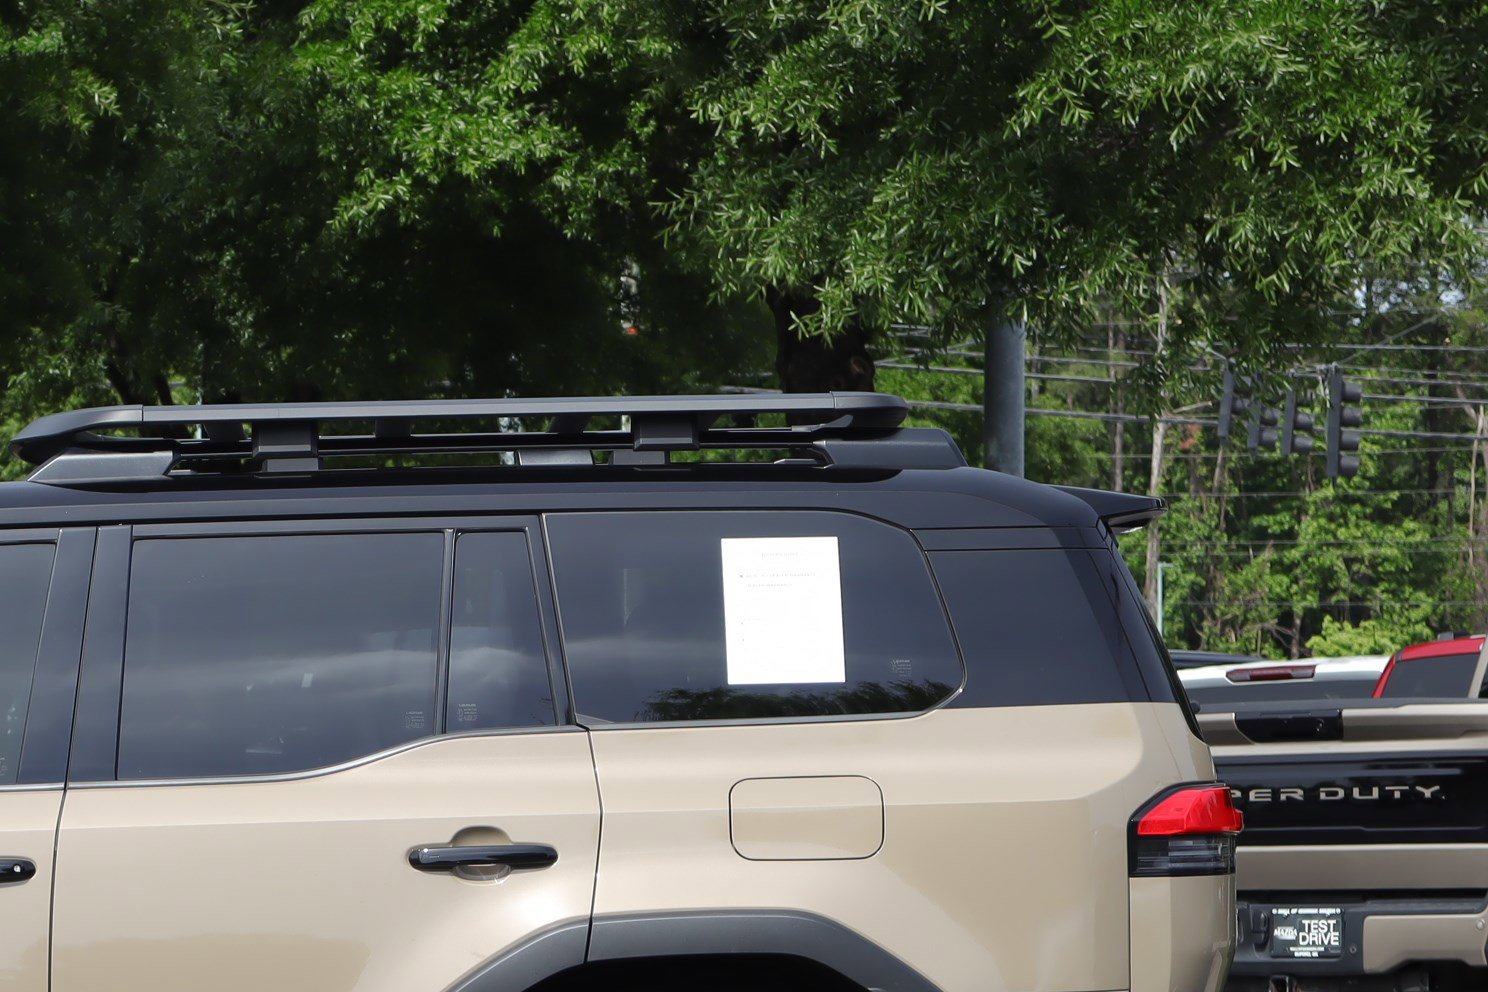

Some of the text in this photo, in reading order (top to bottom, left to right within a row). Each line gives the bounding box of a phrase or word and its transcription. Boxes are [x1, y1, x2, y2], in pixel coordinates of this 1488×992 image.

[1319, 785, 1440, 800] DUTY
[1301, 919, 1337, 933] TEST
[1298, 931, 1340, 946] DRIVE
